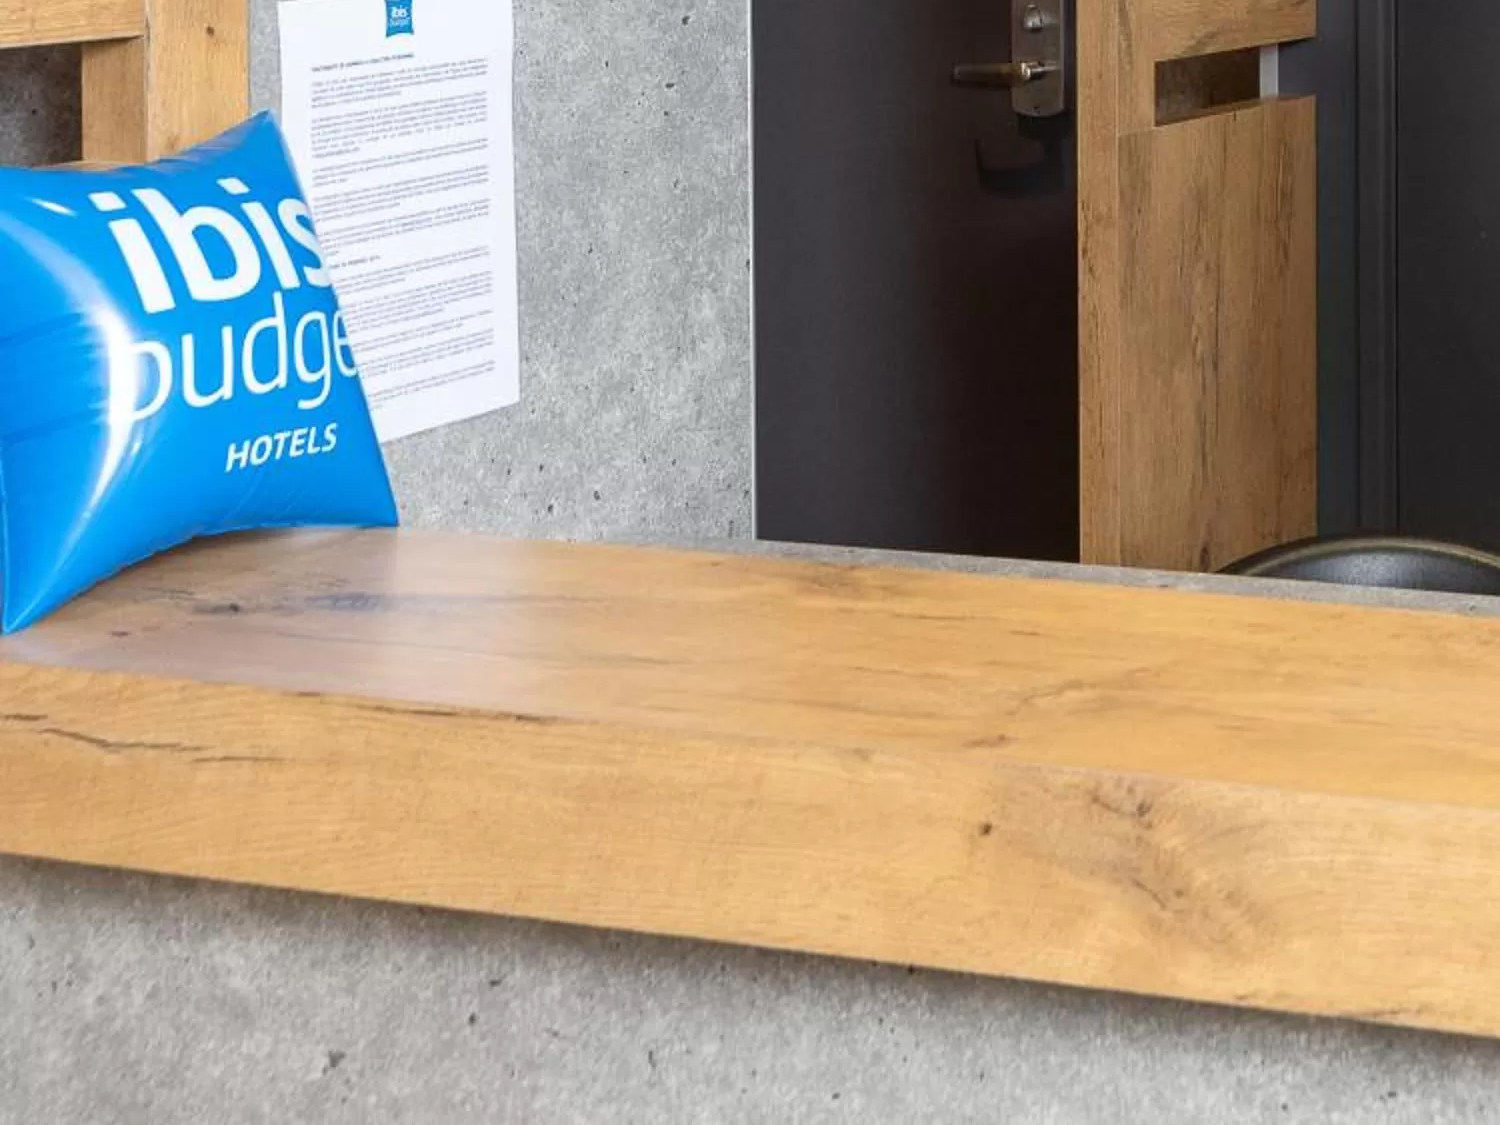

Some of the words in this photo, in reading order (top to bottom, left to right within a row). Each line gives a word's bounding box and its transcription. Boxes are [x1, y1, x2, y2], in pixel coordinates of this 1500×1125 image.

[87, 177, 333, 314] ibis
[113, 291, 358, 423] budge
[225, 423, 338, 473] HOTELS
